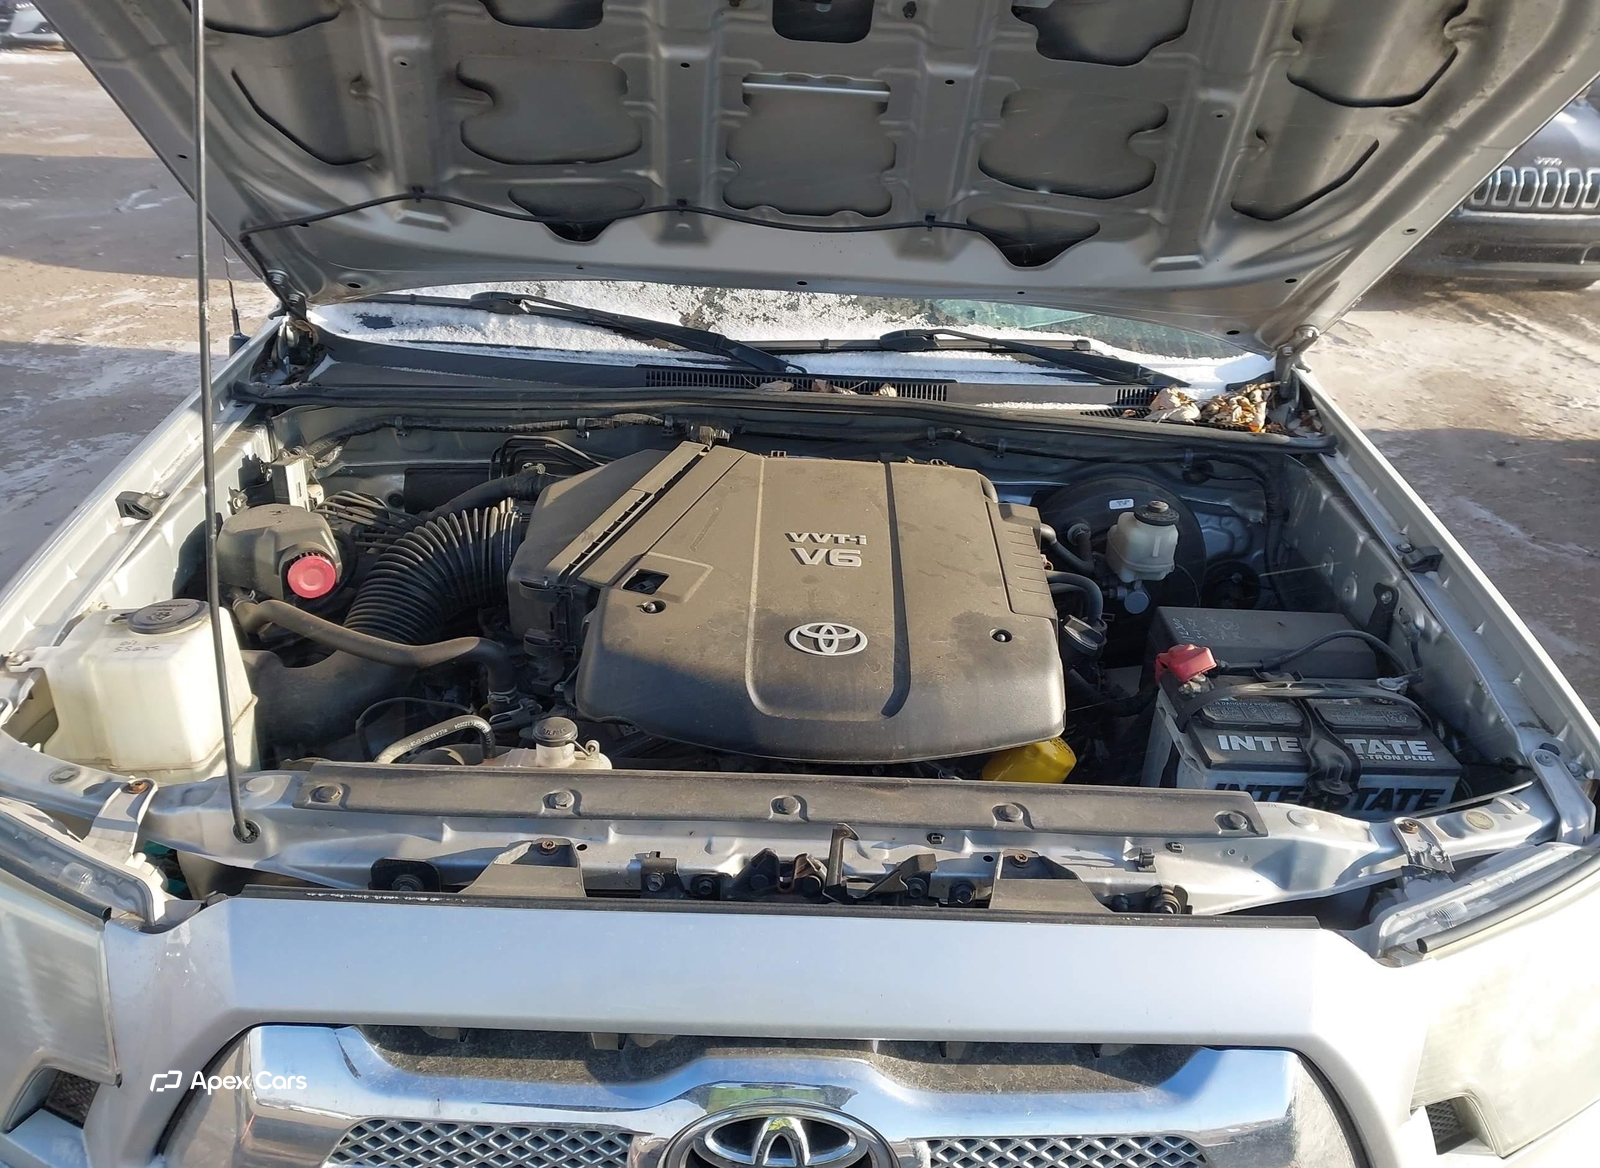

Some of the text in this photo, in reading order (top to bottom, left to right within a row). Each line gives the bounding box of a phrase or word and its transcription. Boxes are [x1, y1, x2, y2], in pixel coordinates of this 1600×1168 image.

[785, 532, 867, 545] VVT-i
[791, 548, 862, 567] V6
[1217, 734, 1433, 756] INTETATE
